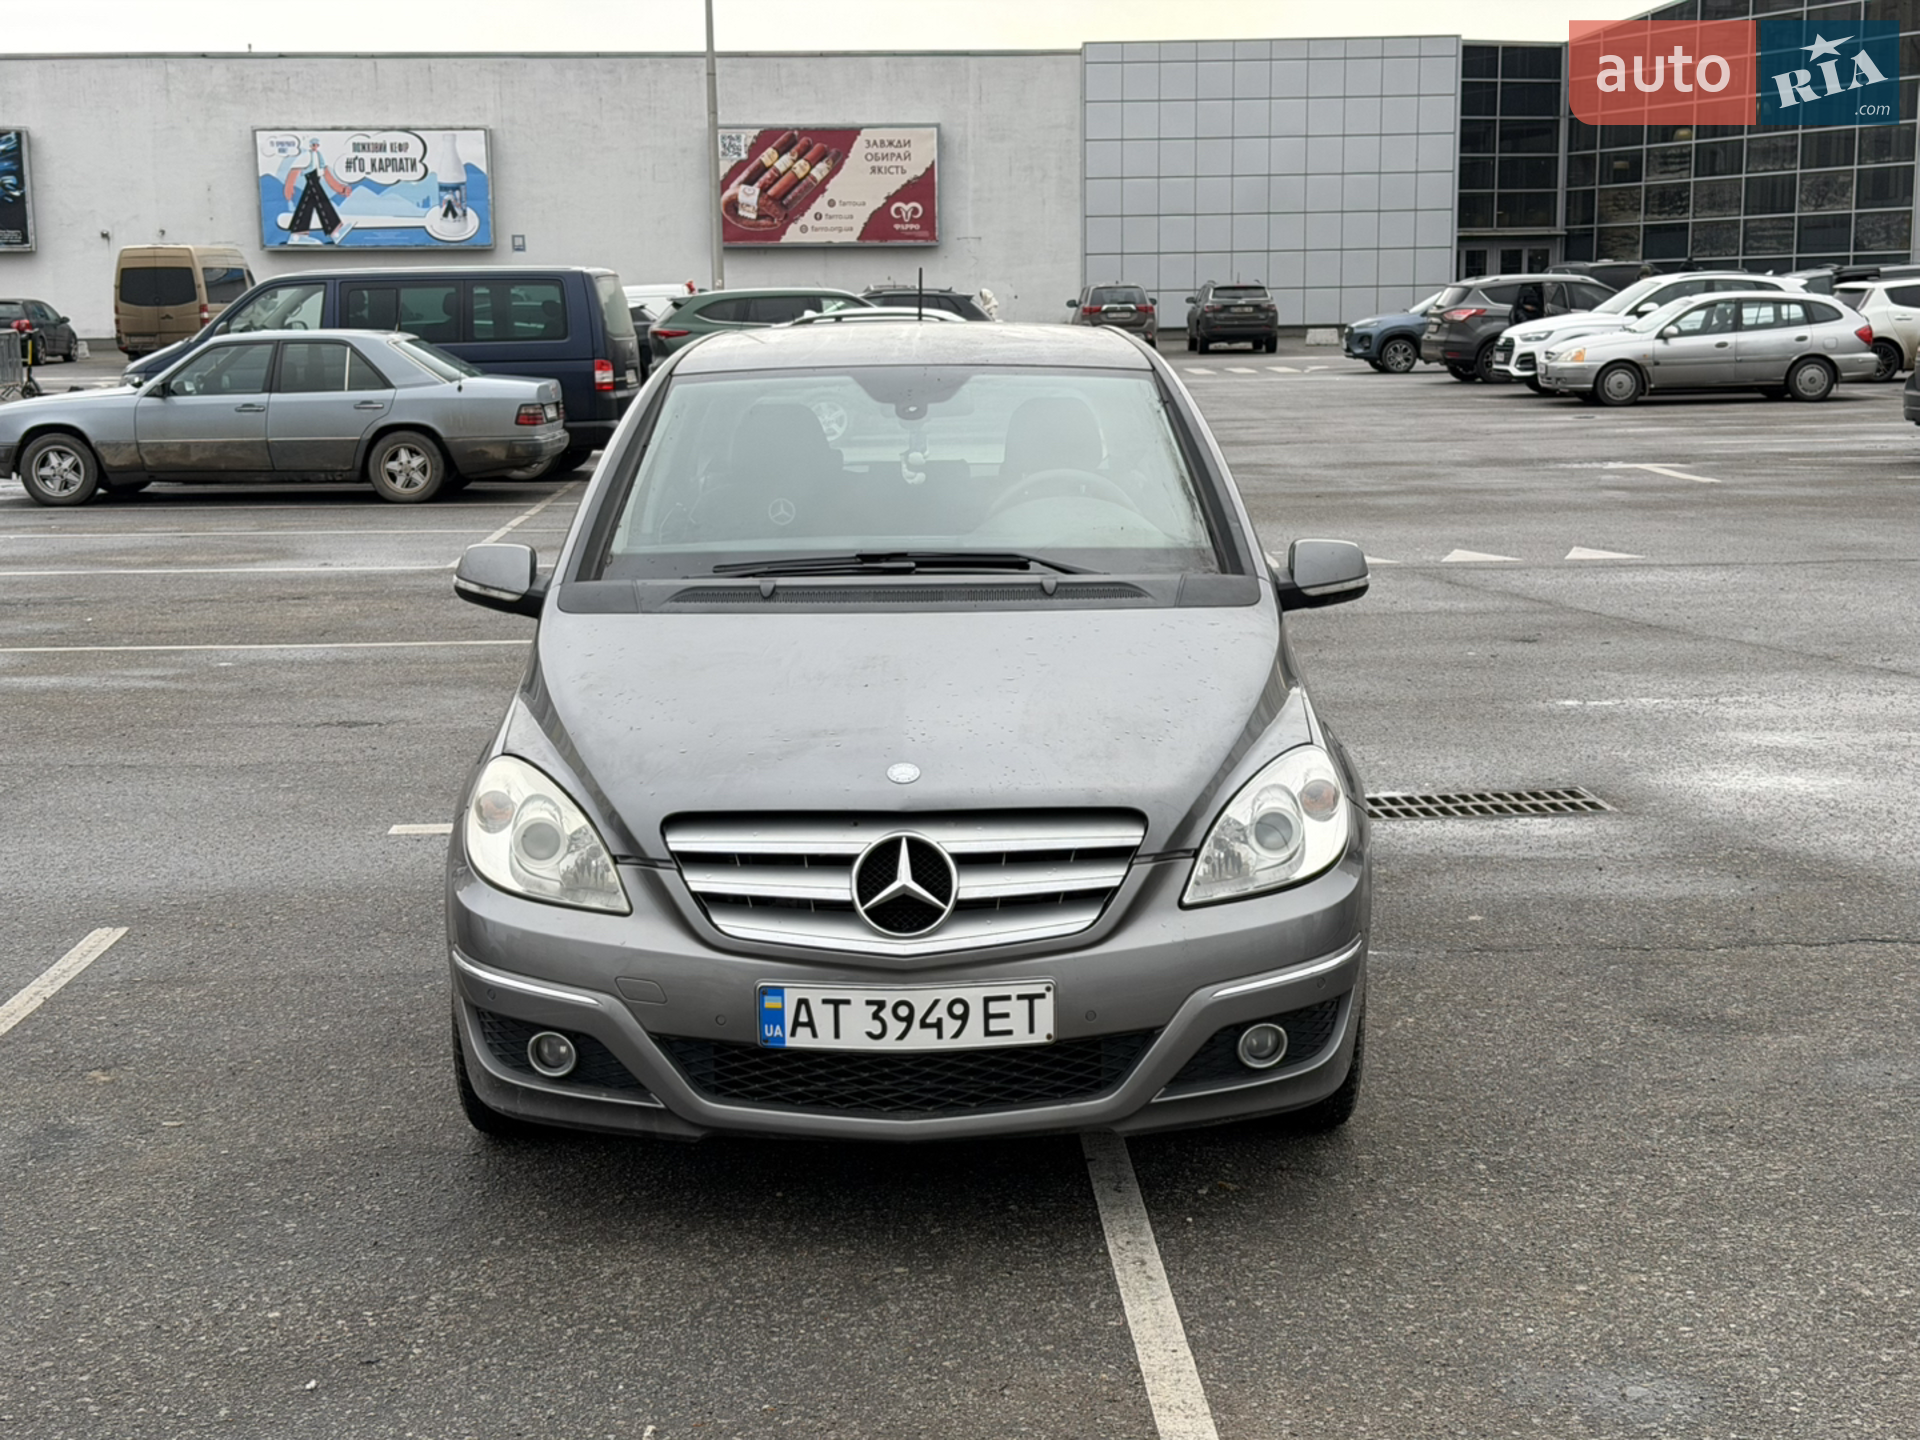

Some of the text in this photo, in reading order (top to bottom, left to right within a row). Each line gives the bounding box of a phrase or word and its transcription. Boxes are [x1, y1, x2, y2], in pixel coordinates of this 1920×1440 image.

[864, 139, 912, 149] ЗАВЖДИ
[864, 150, 912, 162] ОБИРАЙ
[869, 165, 908, 175] ЯКІСТЬ
[789, 992, 1047, 1041] AT 3949 ET
[764, 1023, 784, 1038] UA
